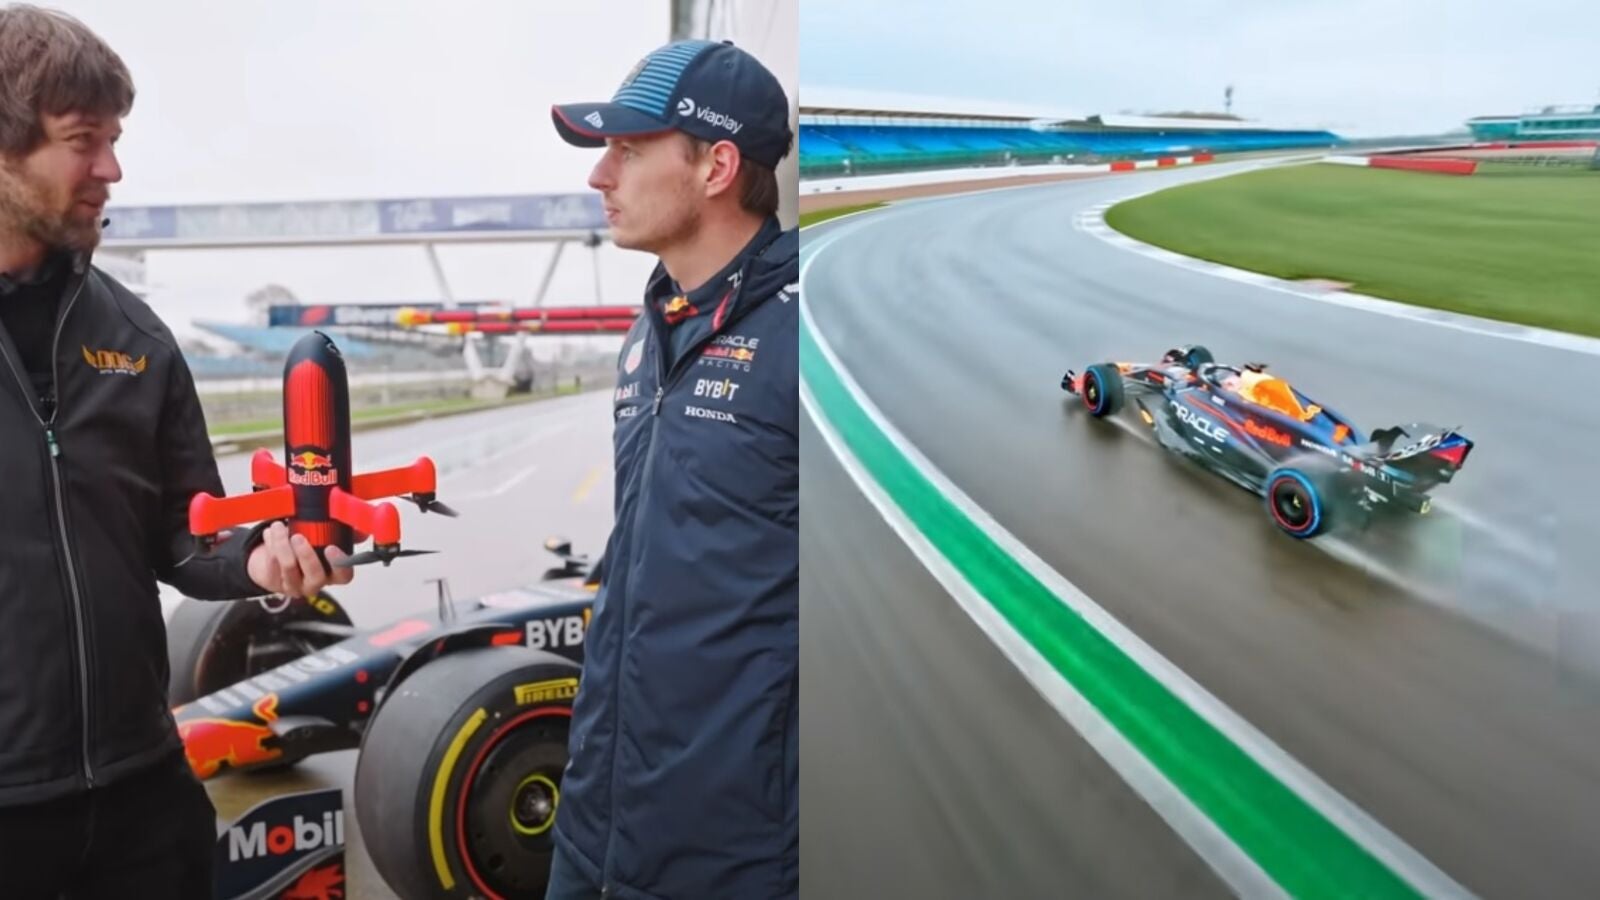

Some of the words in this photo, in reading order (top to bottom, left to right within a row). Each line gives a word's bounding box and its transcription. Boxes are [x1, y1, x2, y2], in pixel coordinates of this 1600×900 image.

[697, 106, 743, 134] viaplay
[698, 359, 751, 372] RACING
[694, 379, 740, 401] BYBIT
[684, 405, 738, 423] HONDA
[1169, 400, 1230, 443] ORACLE
[229, 809, 344, 862] Mobil
